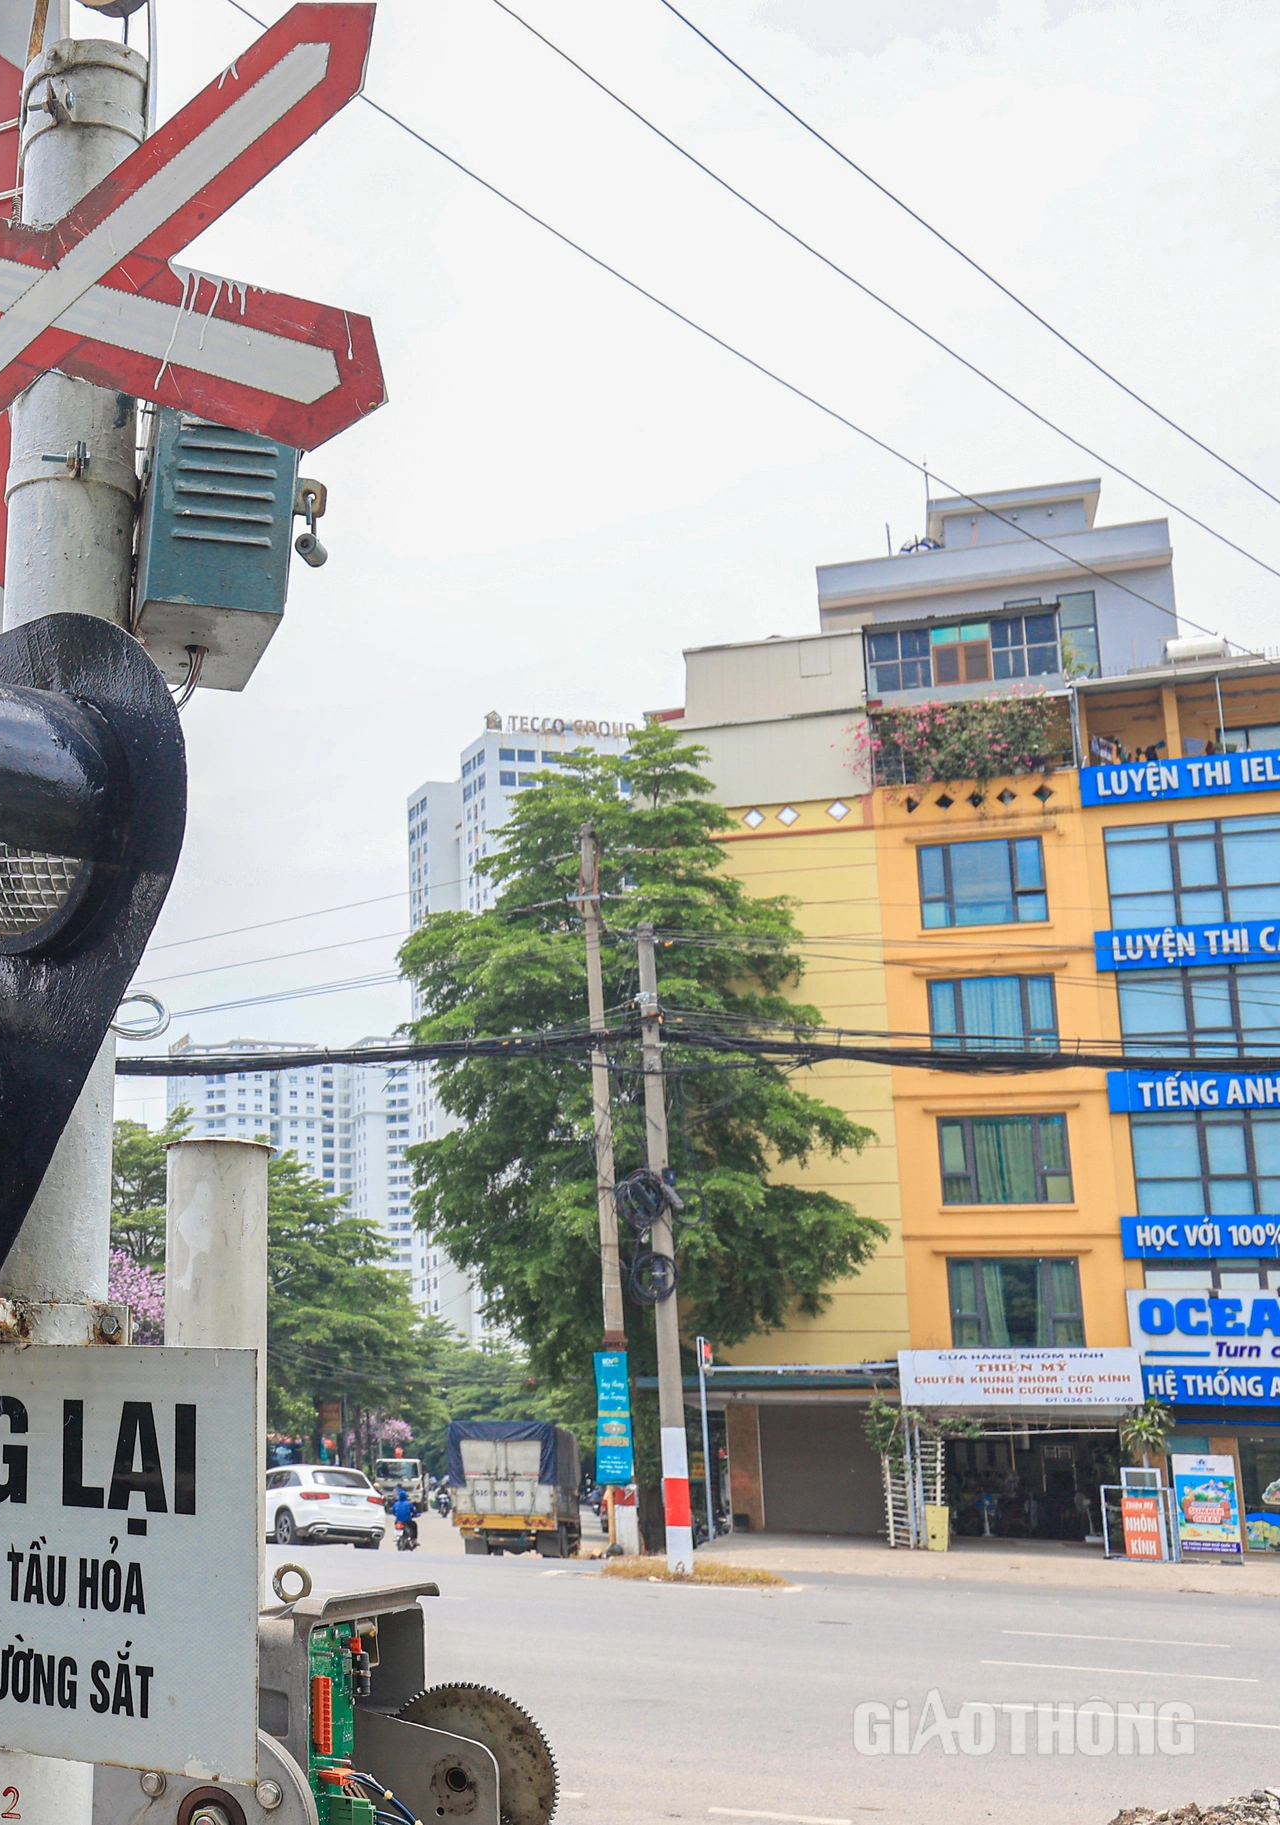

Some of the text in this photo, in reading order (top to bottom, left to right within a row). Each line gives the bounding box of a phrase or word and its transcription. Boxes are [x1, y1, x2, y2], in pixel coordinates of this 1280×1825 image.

[508, 715, 565, 736] TECCO
[1096, 762, 1180, 797] LUYỆN
[1186, 760, 1231, 788] THI
[1112, 926, 1280, 964] LUYỆN THI C
[1138, 1071, 1280, 1107] TIẾNG ANH
[1136, 1217, 1280, 1252] HỌC VỚI 100%
[1139, 1298, 1280, 1336] OCEA
[1020, 1352, 1064, 1360] NHÔM
[1069, 1351, 1104, 1359] KÍNH
[1041, 1359, 1067, 1371] MỸ
[1216, 1341, 1261, 1358] Turn
[914, 1374, 964, 1384] CHUYÊN
[970, 1375, 1014, 1384] KHUNG
[1019, 1374, 1058, 1383] NHÔM
[1099, 1373, 1131, 1382] KÍNH
[983, 1386, 1014, 1394] KÍNH
[1148, 1369, 1179, 1402] HỆ
[1182, 1368, 1264, 1398] THỐNG
[62, 1399, 197, 1536] LẠI
[1125, 1513, 1157, 1532] NHÔM
[1131, 1536, 1157, 1556] KÍNH
[7, 1535, 68, 1606] TẦU
[78, 1535, 146, 1615] HỎA
[90, 1641, 154, 1719] SẮT
